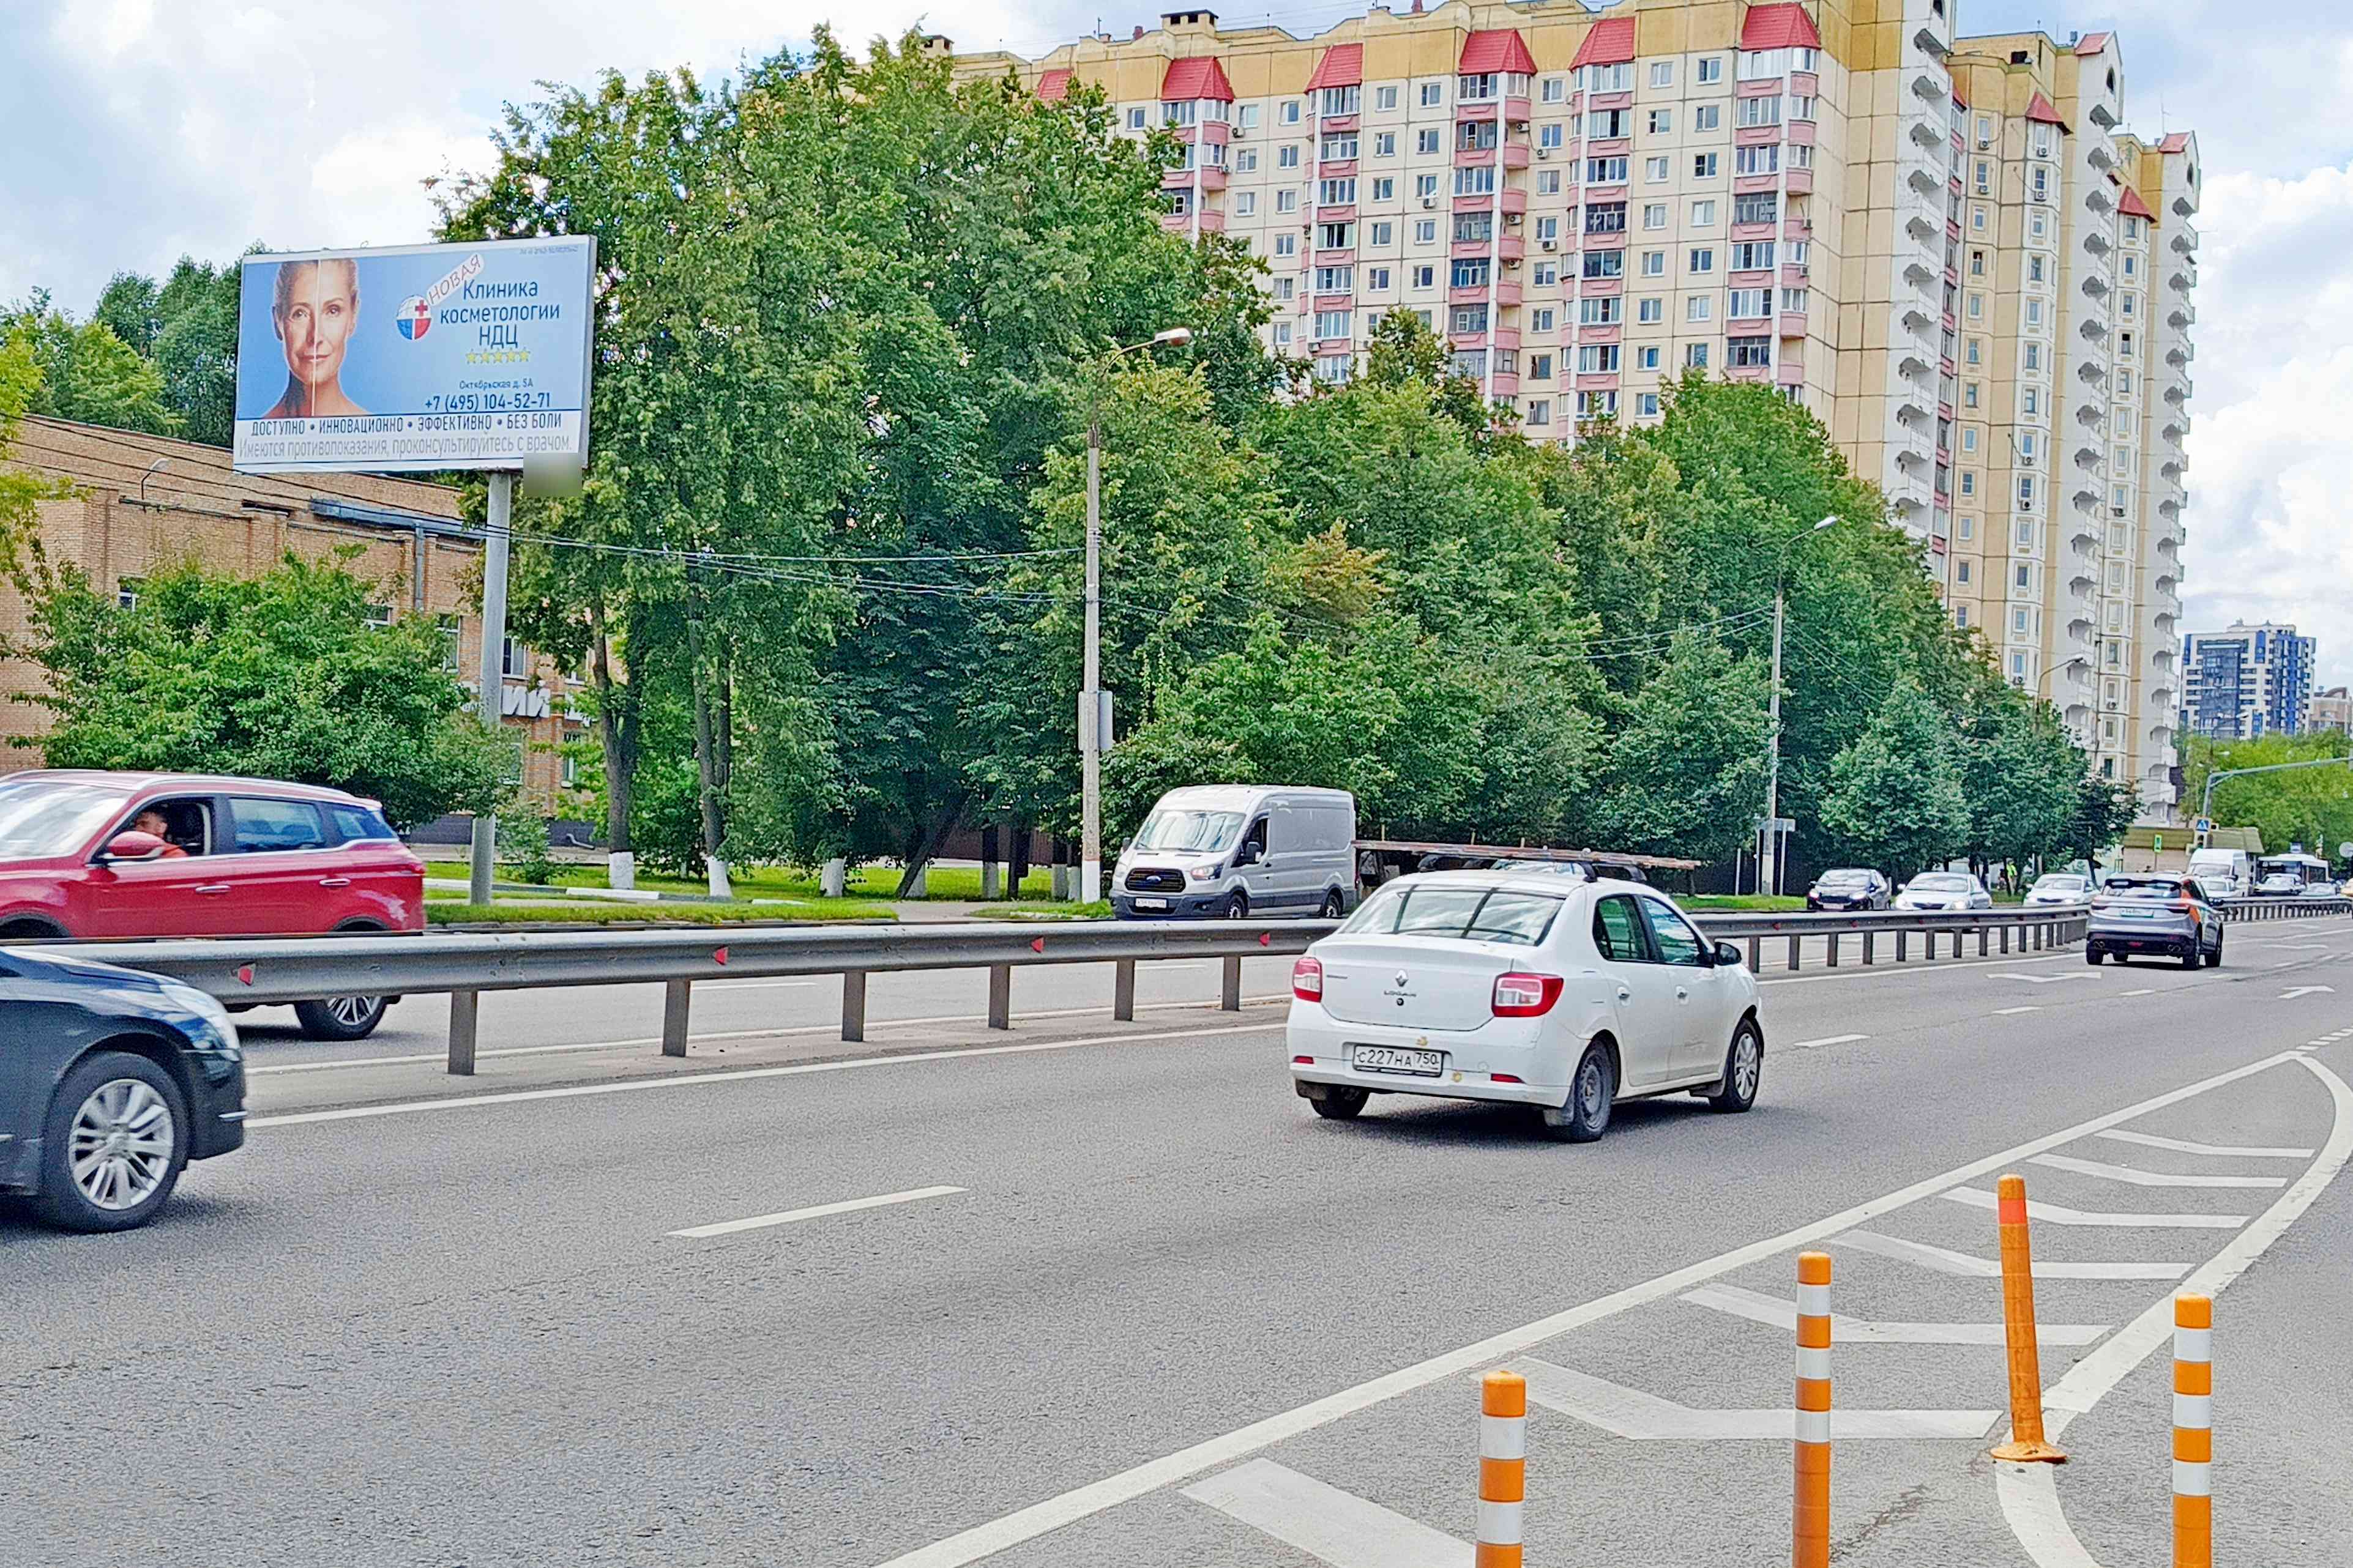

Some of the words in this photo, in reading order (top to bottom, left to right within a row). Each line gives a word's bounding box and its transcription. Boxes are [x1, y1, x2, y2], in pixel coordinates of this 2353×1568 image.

[428, 254, 481, 305] НОВАЯ
[463, 280, 538, 300] Клиника
[440, 303, 560, 324] косметологии
[479, 324, 518, 349] НДЦ
[425, 396, 441, 411] +7
[445, 393, 479, 412] (495)
[484, 392, 551, 409] 104-52-71
[251, 420, 305, 436] ДОСТУПНО
[319, 417, 403, 434] ИННОВАЦИОННО
[417, 415, 492, 431] ЭФФЕКТИВНО
[507, 414, 528, 429] БЕЗ
[532, 413, 562, 428] БОЛИ
[239, 438, 285, 458] Имеются
[288, 439, 389, 459] противопоказания,
[392, 431, 514, 459] проконсультируйтесь
[517, 436, 523, 450] с
[528, 434, 572, 453] врачом.
